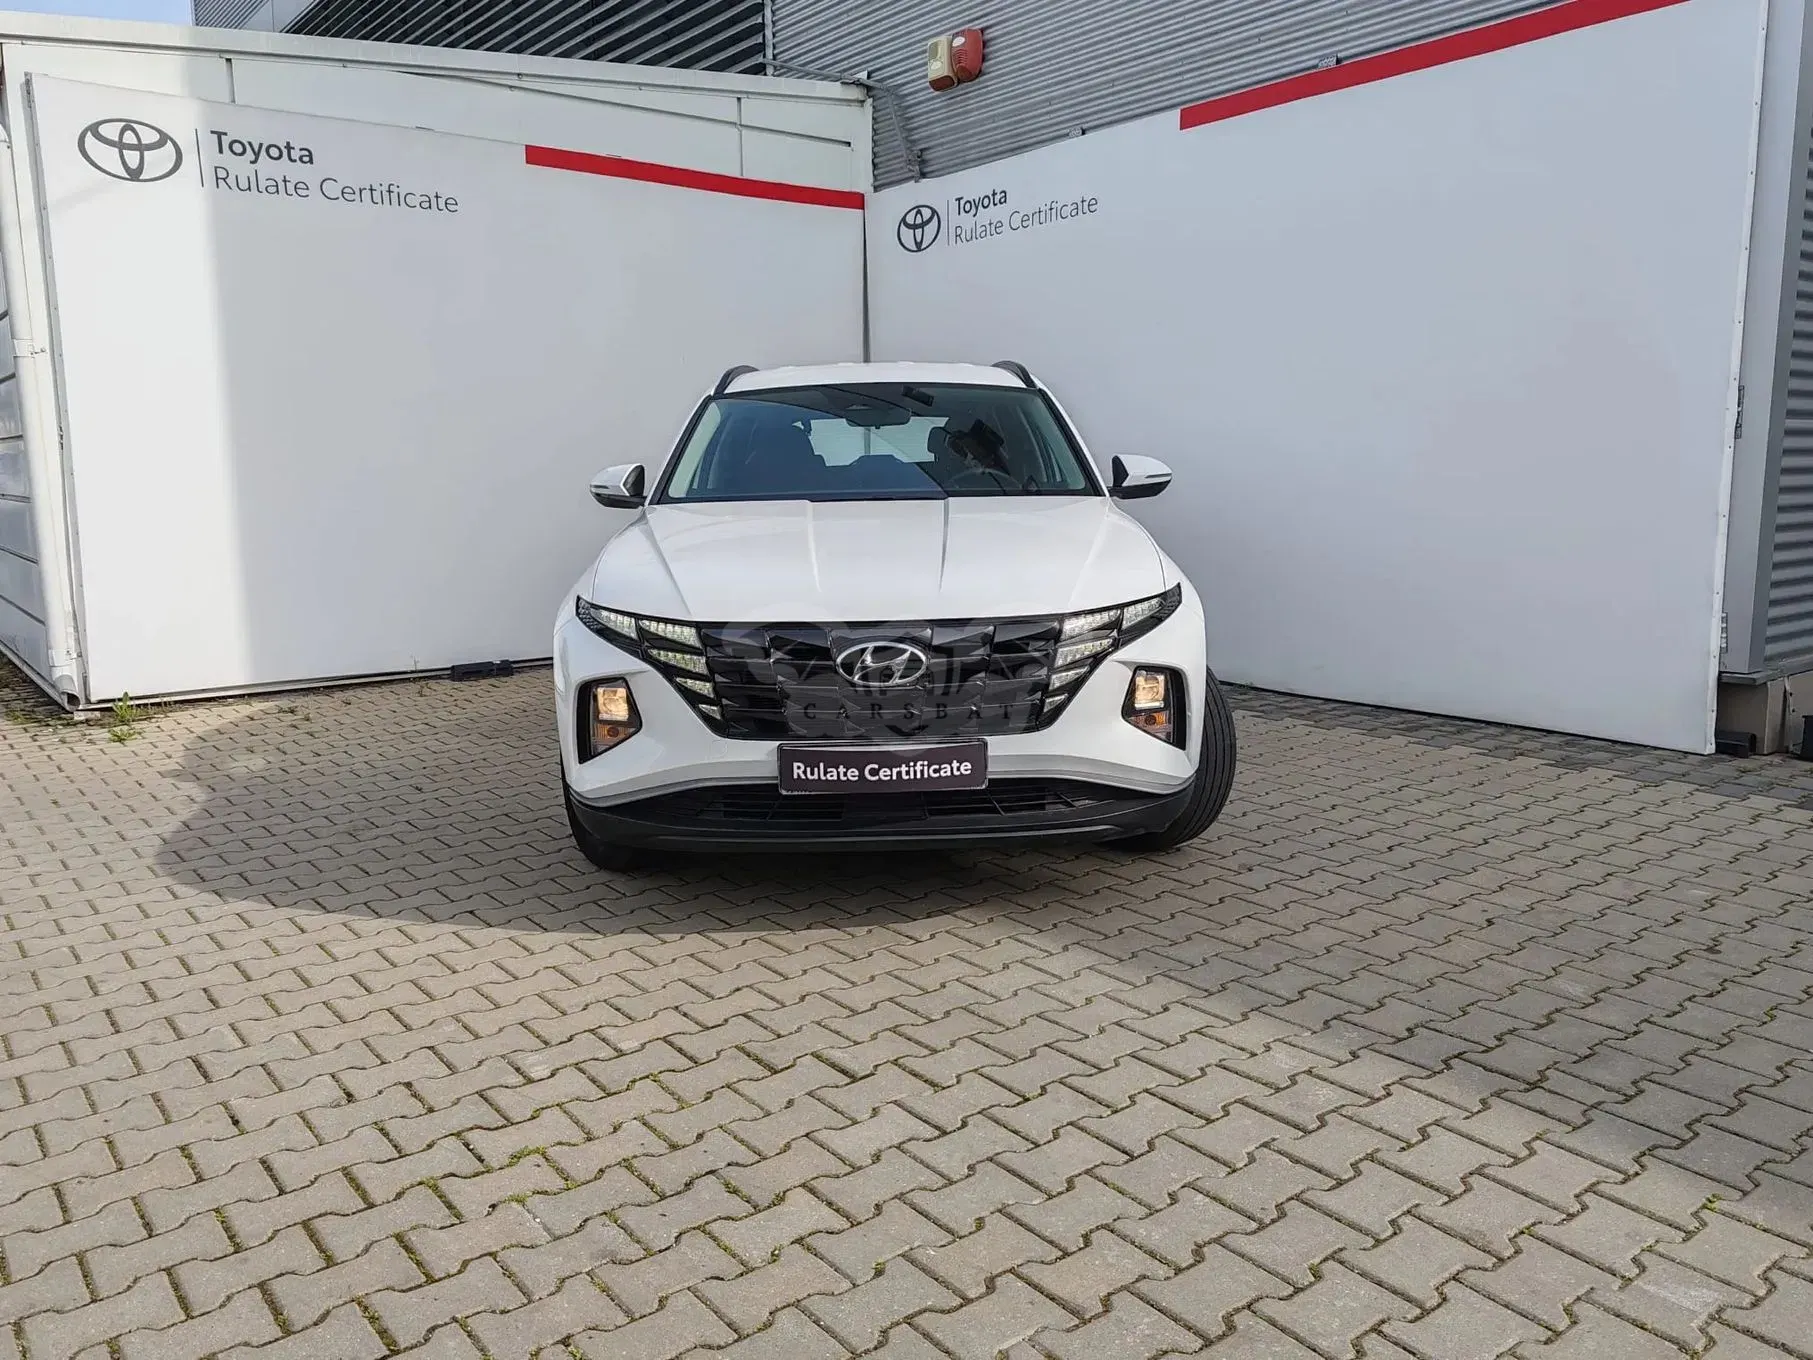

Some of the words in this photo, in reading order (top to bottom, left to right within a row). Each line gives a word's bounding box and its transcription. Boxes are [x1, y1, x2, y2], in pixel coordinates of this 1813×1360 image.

[210, 130, 315, 166] Toyota
[213, 165, 310, 198] Rulate
[319, 176, 459, 213] Certificate
[955, 188, 1008, 218] Toyota
[954, 219, 1004, 245] Rulate
[1008, 195, 1098, 232] Certificate
[792, 761, 860, 781] Rulate
[864, 759, 972, 781] Certificate
